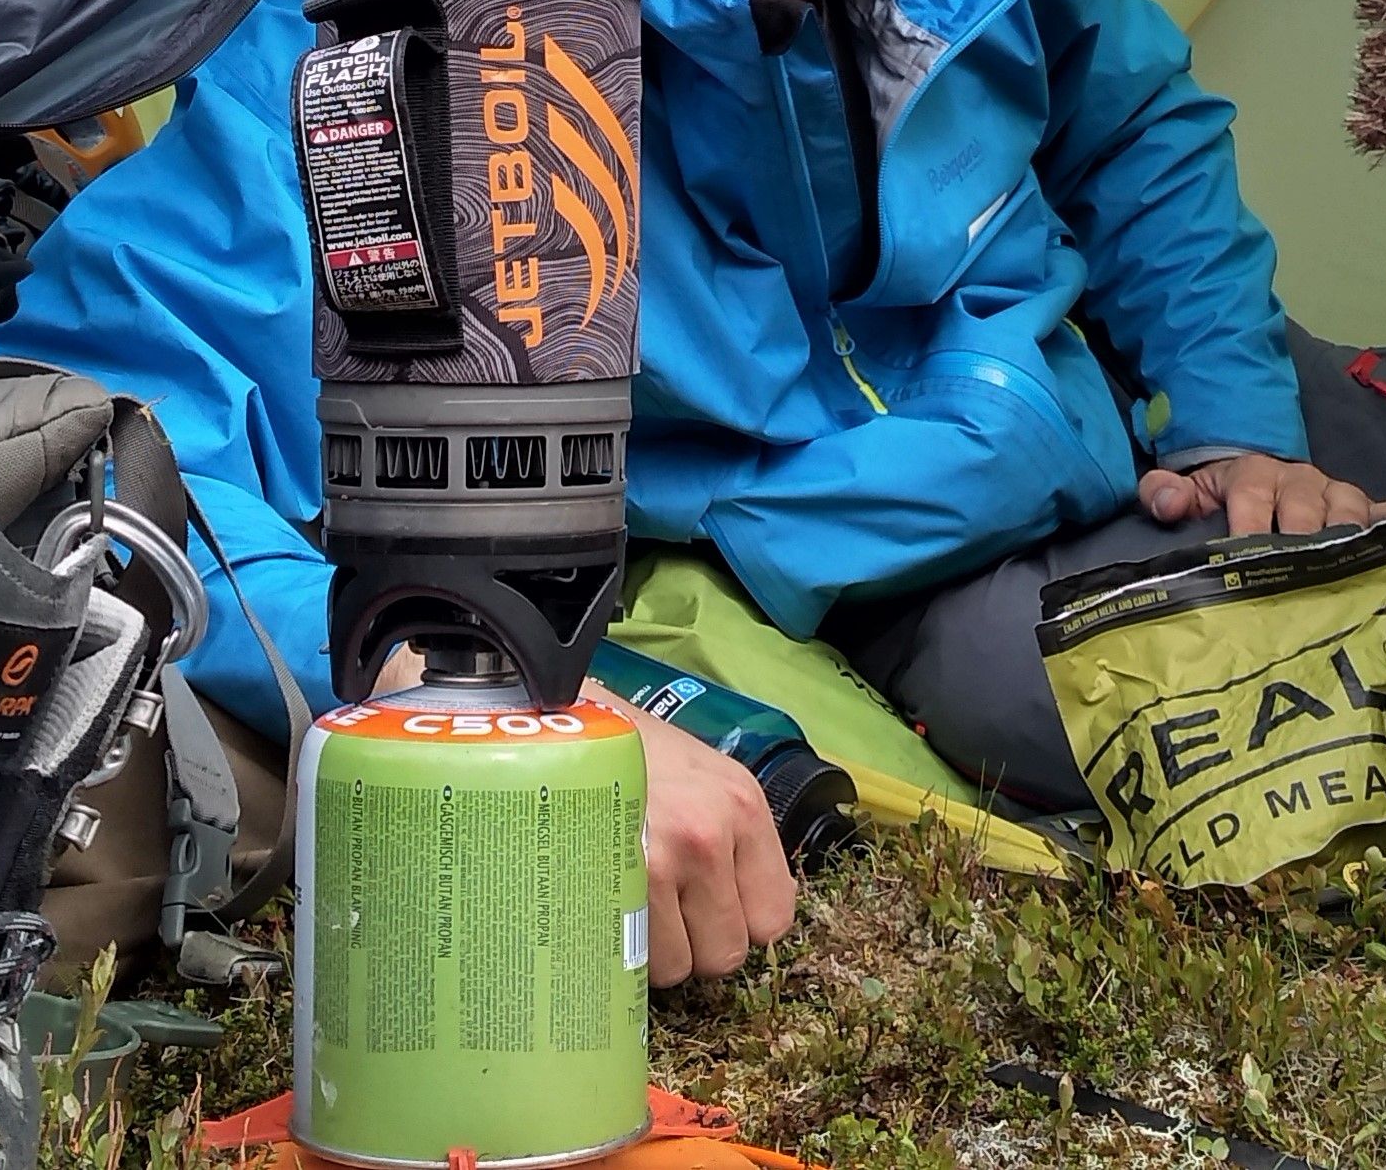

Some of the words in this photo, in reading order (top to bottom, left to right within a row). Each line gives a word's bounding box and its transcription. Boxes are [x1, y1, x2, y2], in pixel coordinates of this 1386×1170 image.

[306, 53, 383, 74] JETBOIL
[306, 63, 386, 88] FLASH
[306, 89, 321, 97] Use
[323, 82, 366, 94] Outdoors
[367, 78, 386, 88] Only
[330, 122, 385, 140] DANGER
[480, 14, 544, 348] JETBOIL
[327, 232, 412, 250] www.jetboil.com
[367, 247, 395, 262] 警告
[403, 713, 585, 736] C500
[351, 796, 364, 882] BUTAN/PROPAN
[439, 802, 454, 871] GASGEMISCH
[537, 803, 551, 852] MENGSEL
[612, 798, 622, 850] MELANGE
[612, 852, 622, 896] BUTANE
[351, 884, 363, 950] BLANNING
[437, 874, 453, 959] BUTAN/PROPAN
[536, 855, 550, 947] BUTAAN/PROPAN
[611, 907, 621, 957] PROPANE
